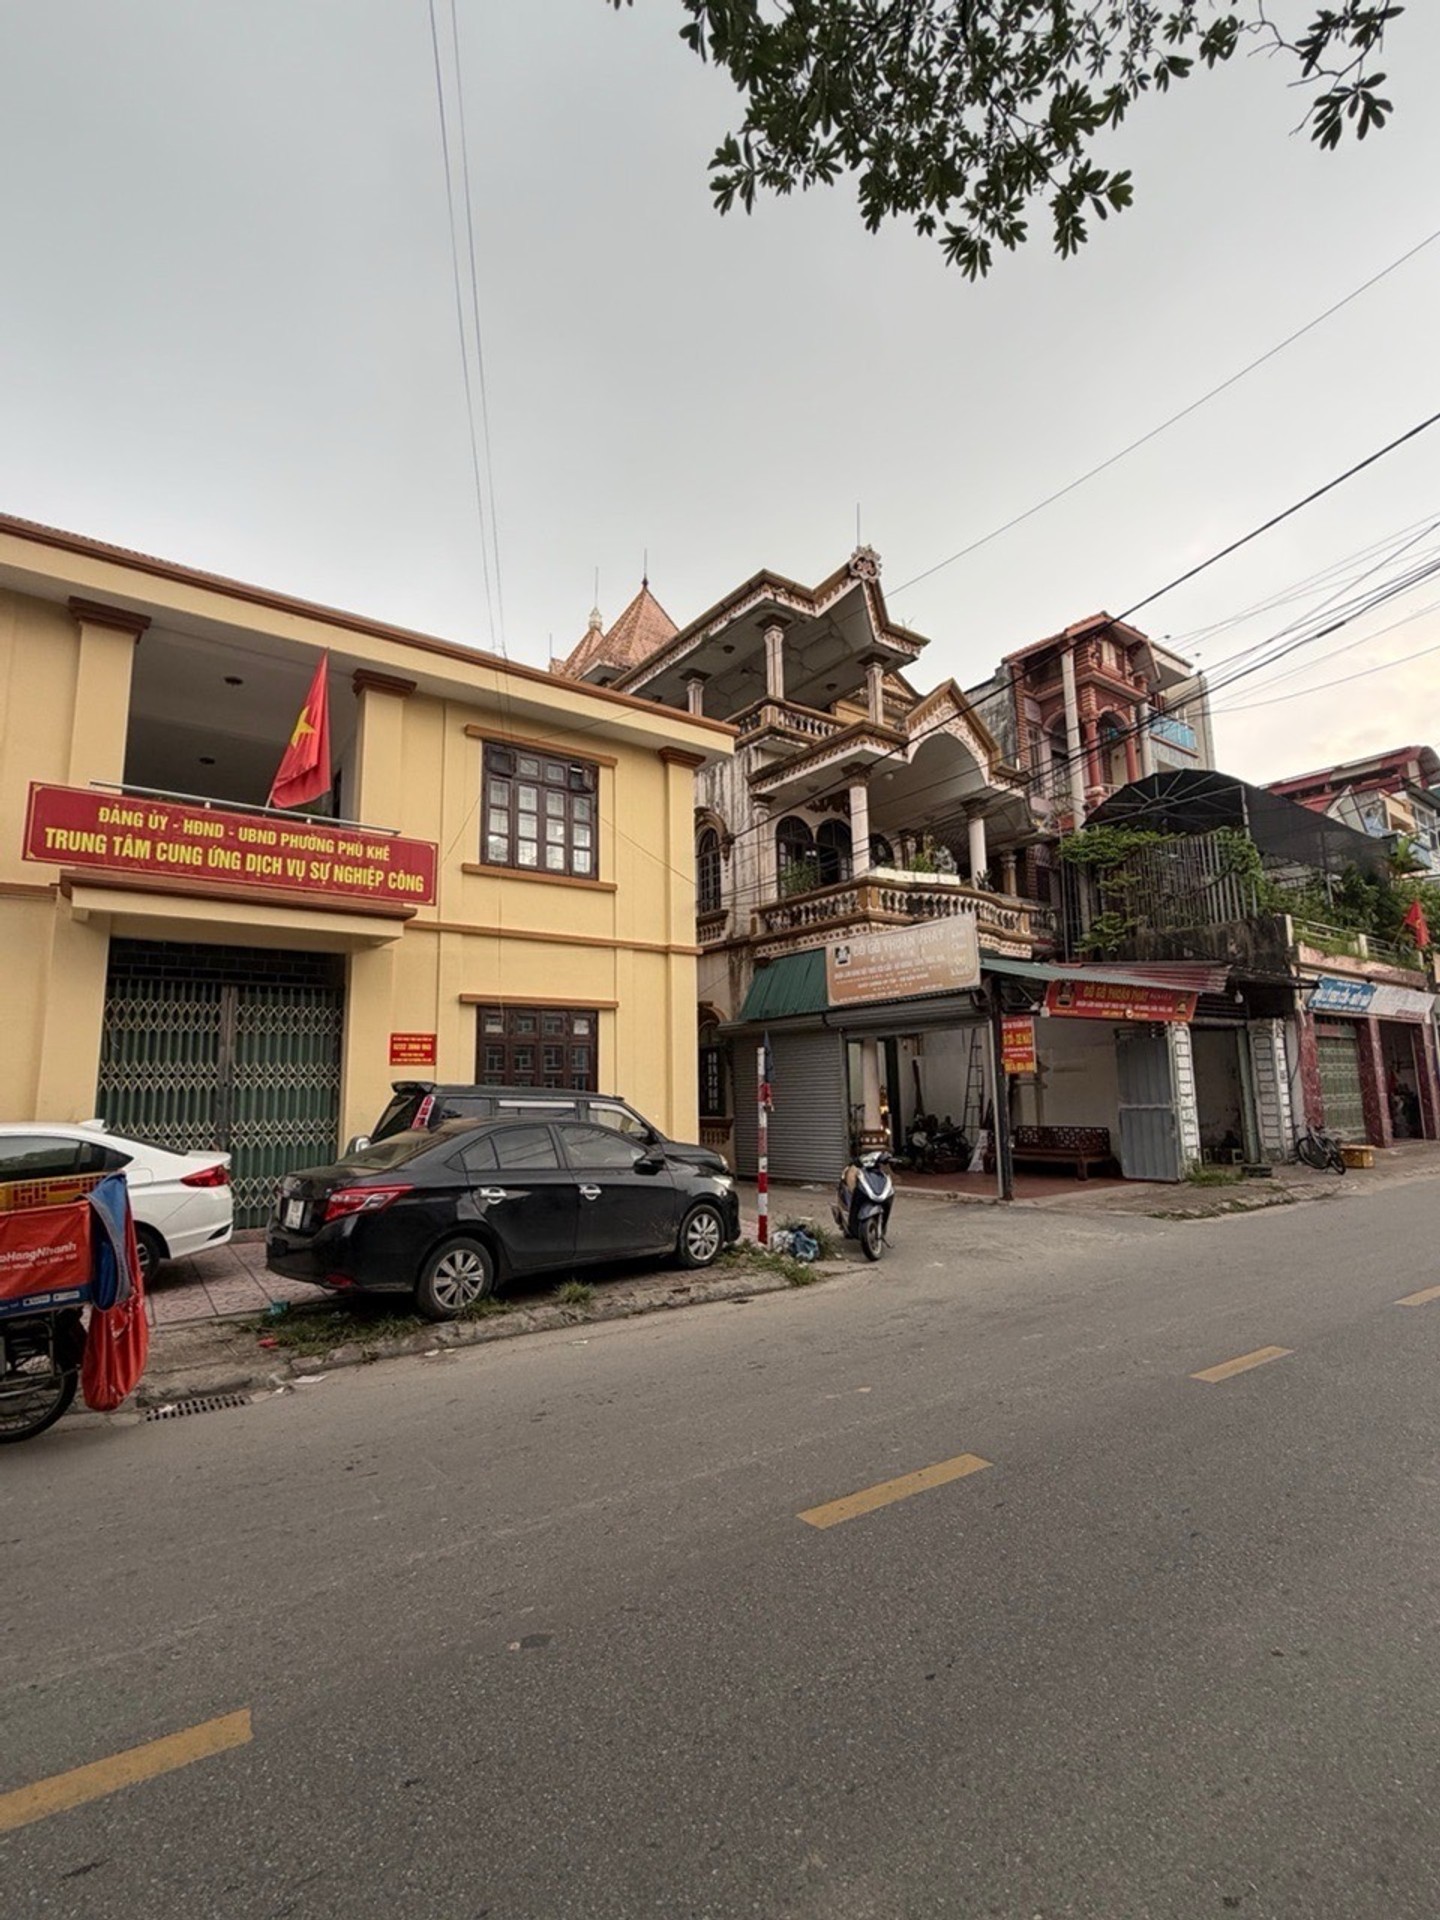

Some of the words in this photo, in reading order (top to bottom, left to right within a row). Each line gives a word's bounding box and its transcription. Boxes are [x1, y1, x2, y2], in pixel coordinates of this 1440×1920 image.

[99, 804, 143, 827] ĐẢNG
[148, 809, 169, 830] ỦY
[183, 818, 224, 838] HĐND
[238, 826, 276, 845] UBND
[280, 831, 334, 853] PHƯỜNG
[45, 827, 107, 855] TRUNG
[113, 833, 151, 859] TÂM
[156, 842, 202, 866] CUNG
[208, 845, 241, 870] ỨNG
[246, 853, 282, 877] DỊCH
[286, 858, 306, 881] VỤ
[309, 861, 331, 884] SỰ
[333, 865, 385, 891] NGHIỆP
[388, 869, 425, 893] CÔNG
